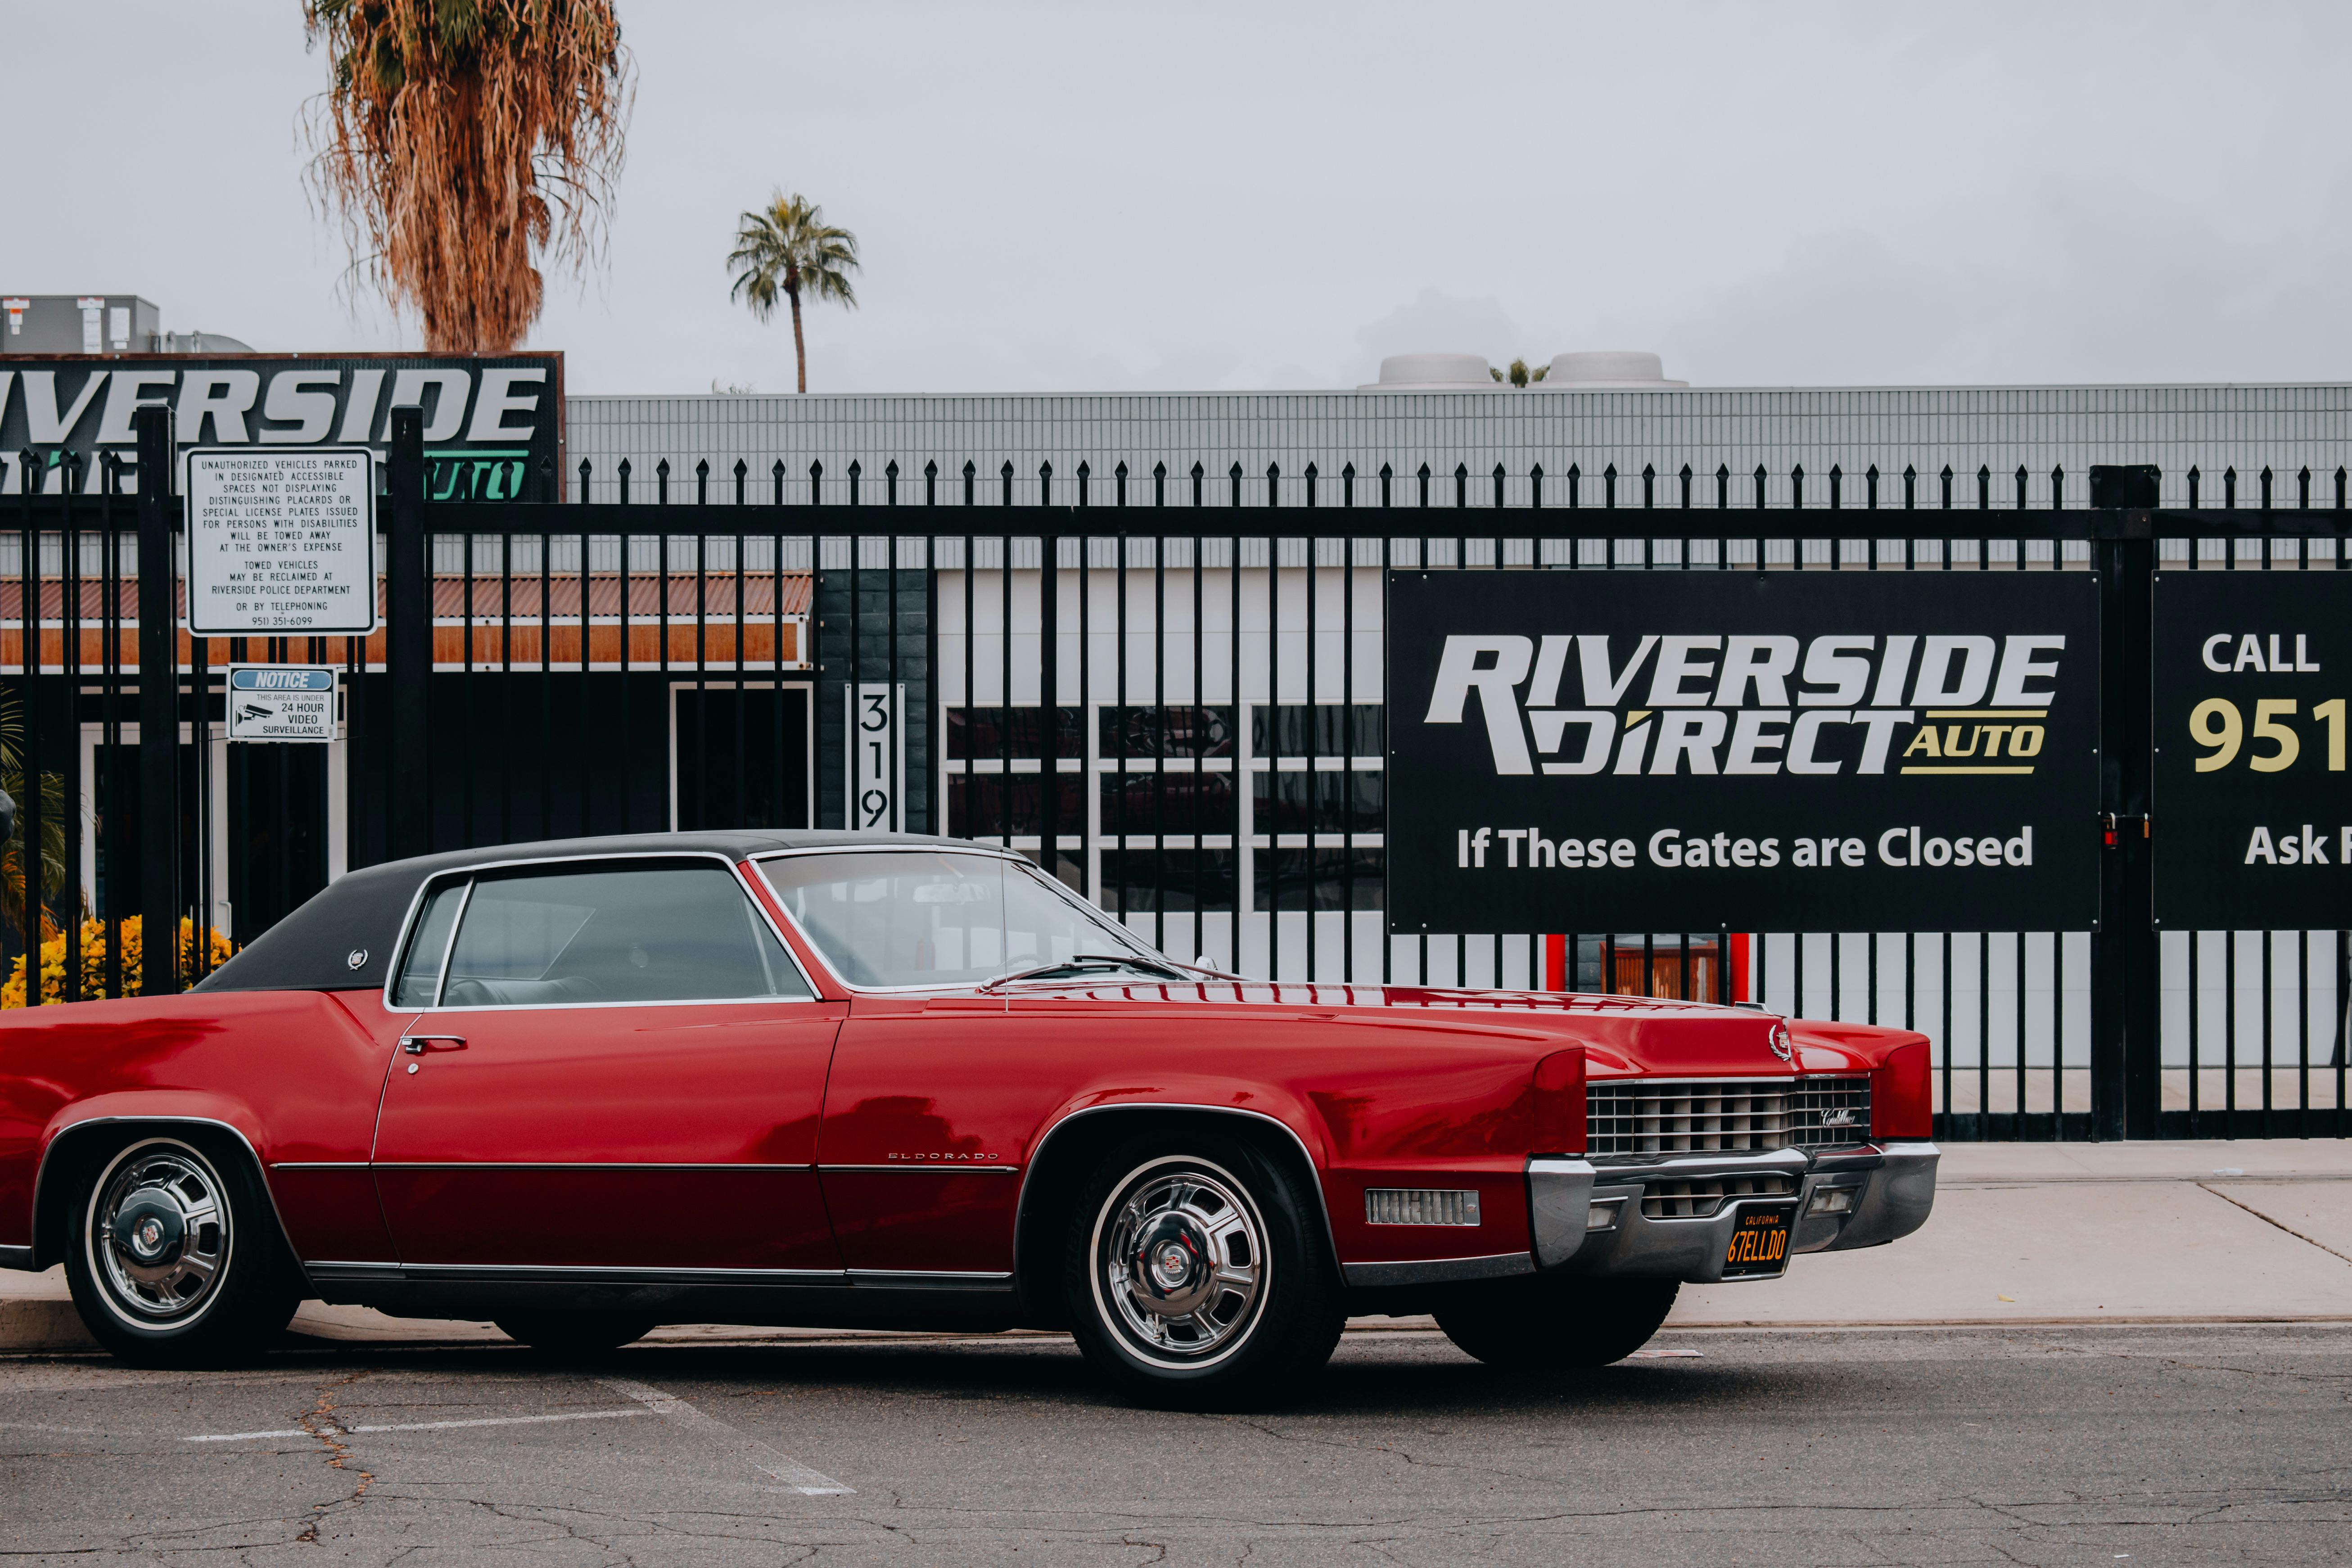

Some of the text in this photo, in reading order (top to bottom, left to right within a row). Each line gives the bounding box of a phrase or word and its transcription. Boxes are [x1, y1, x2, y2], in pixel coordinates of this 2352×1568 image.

[0, 370, 546, 443] VERSIDE
[202, 461, 268, 469] UNAUTHORIZED
[275, 461, 316, 469] VEHICLES
[232, 473, 284, 481] DESIGNATED
[291, 472, 343, 480] ACCESSIBLE
[382, 462, 524, 500] UTO
[263, 484, 278, 493] NOT
[286, 484, 336, 492] DISPLAYING
[210, 496, 350, 505] DISTINGUISHING PLACARDS OR
[289, 508, 319, 516] PLATES
[327, 507, 357, 515] ISSUED
[204, 520, 219, 529] FOR
[227, 520, 266, 528] PERSONS
[301, 519, 357, 528] DISABILITIES
[257, 532, 268, 540] BE
[258, 543, 296, 551] OWNER'S
[304, 543, 342, 551] EXPENSE
[245, 561, 318, 569] TOWED VEHICLES
[271, 573, 317, 581] RECLAIMED
[212, 586, 256, 594] RIVERSIDE
[260, 586, 290, 594] POLICE
[236, 603, 247, 611] OR
[271, 602, 327, 610] TELEPHONING
[273, 617, 312, 625] 351-6099
[2203, 634, 2320, 672] CALL
[255, 672, 310, 688] NOTICE
[282, 703, 323, 712] 24 HOUR
[1424, 635, 2065, 775] RIVERSIDE
[288, 715, 317, 724] VIDEO
[2189, 698, 2345, 772] 951
[1903, 725, 2045, 757] AUTO
[860, 695, 888, 827] 319
[1458, 826, 2032, 868] If These Gates are Closed
[2244, 825, 2329, 864] Ask
[1746, 1215, 1779, 1225] CALIFORNIA
[1728, 1229, 1786, 1262] 67ELLDO
